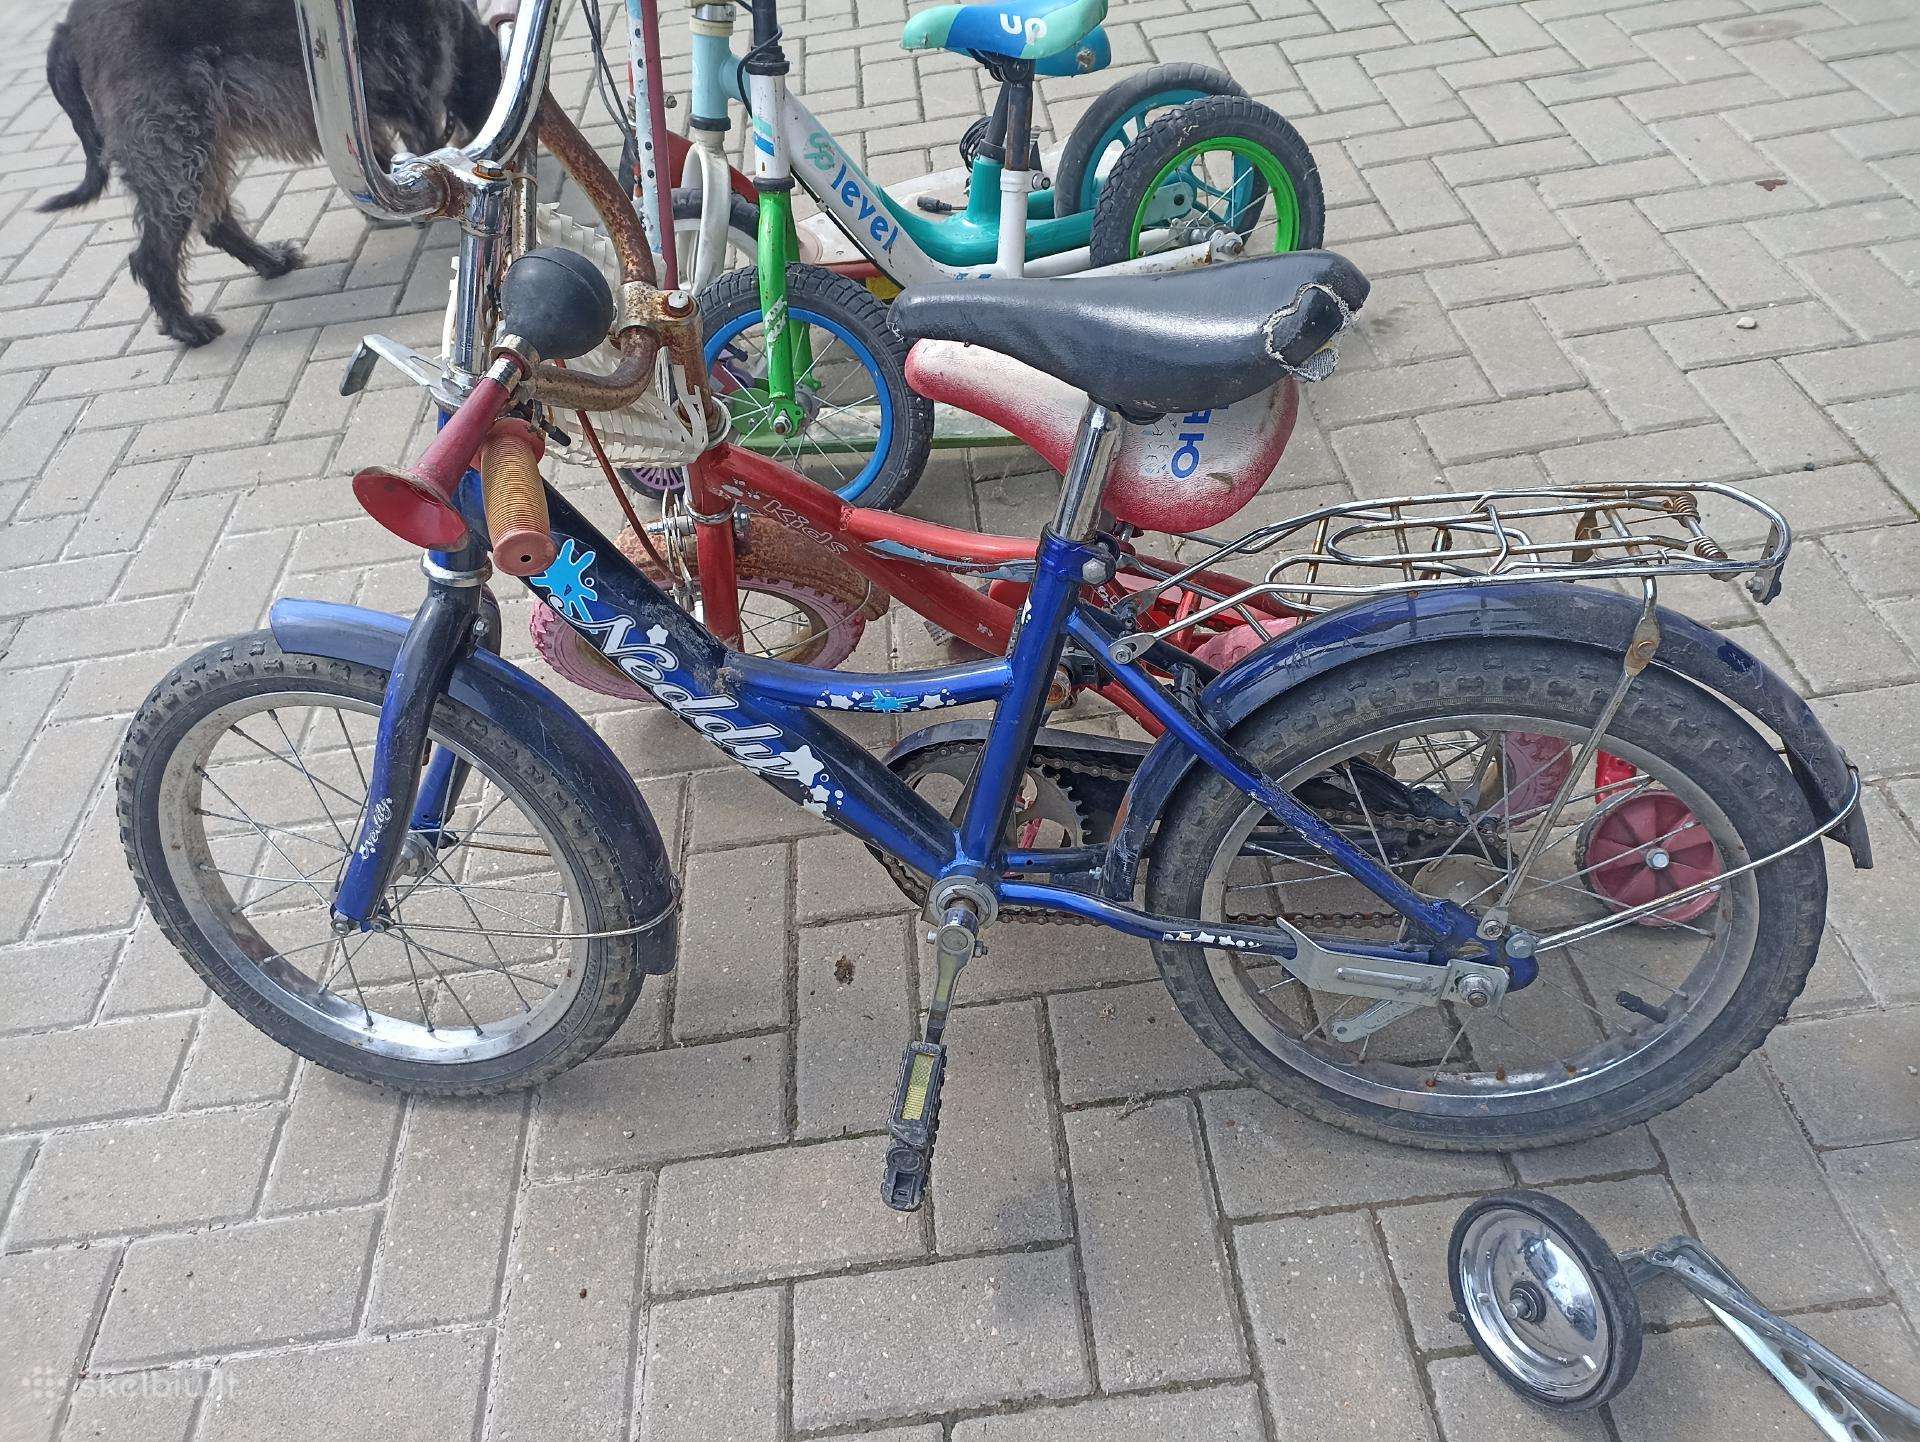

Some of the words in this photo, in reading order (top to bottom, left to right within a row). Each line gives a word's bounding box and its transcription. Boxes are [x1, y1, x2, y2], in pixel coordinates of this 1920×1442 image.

[1000, 13, 1047, 45] up
[831, 163, 899, 251] level
[547, 593, 799, 777] Neddy
